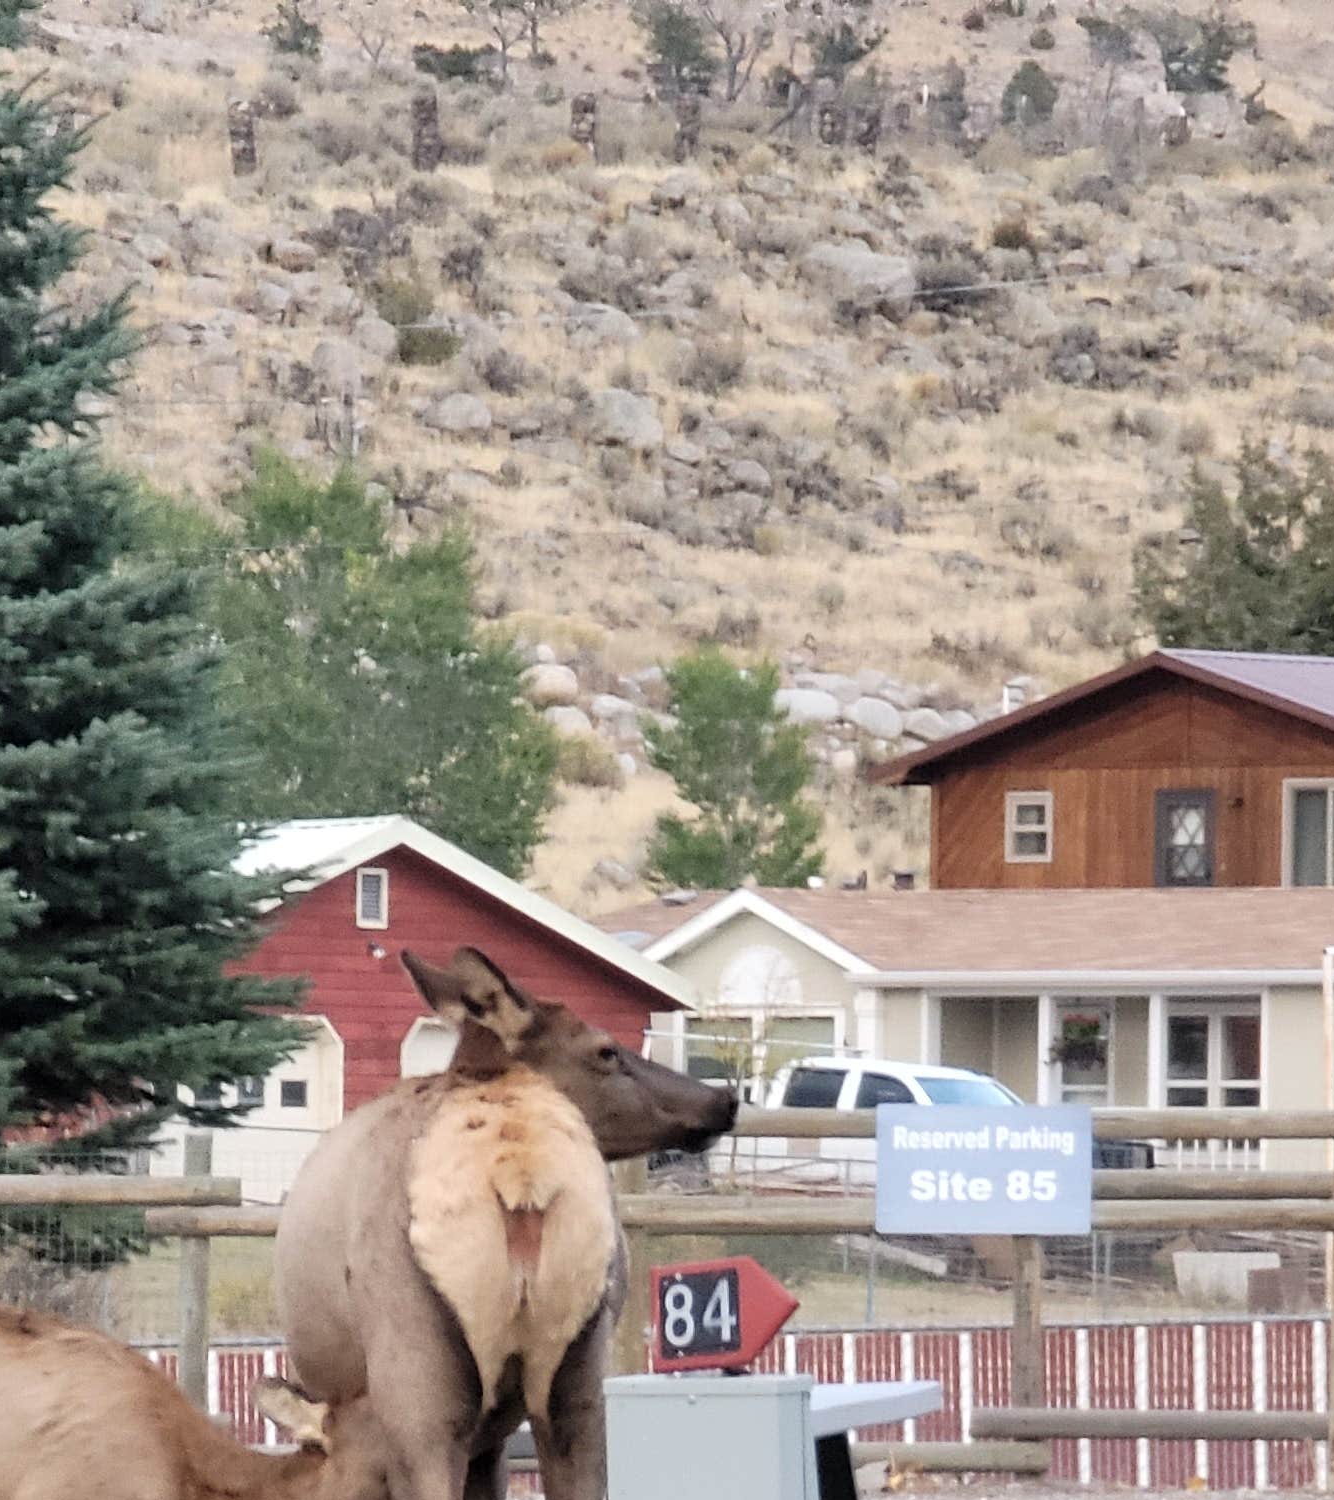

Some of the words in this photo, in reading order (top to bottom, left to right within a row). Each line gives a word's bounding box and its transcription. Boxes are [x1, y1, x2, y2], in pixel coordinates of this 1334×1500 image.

[892, 1126, 990, 1150] Reserved
[995, 1126, 1075, 1155] Parking
[909, 1170, 993, 1201] Site
[1005, 1170, 1057, 1201] 85
[664, 1278, 737, 1347] 84
